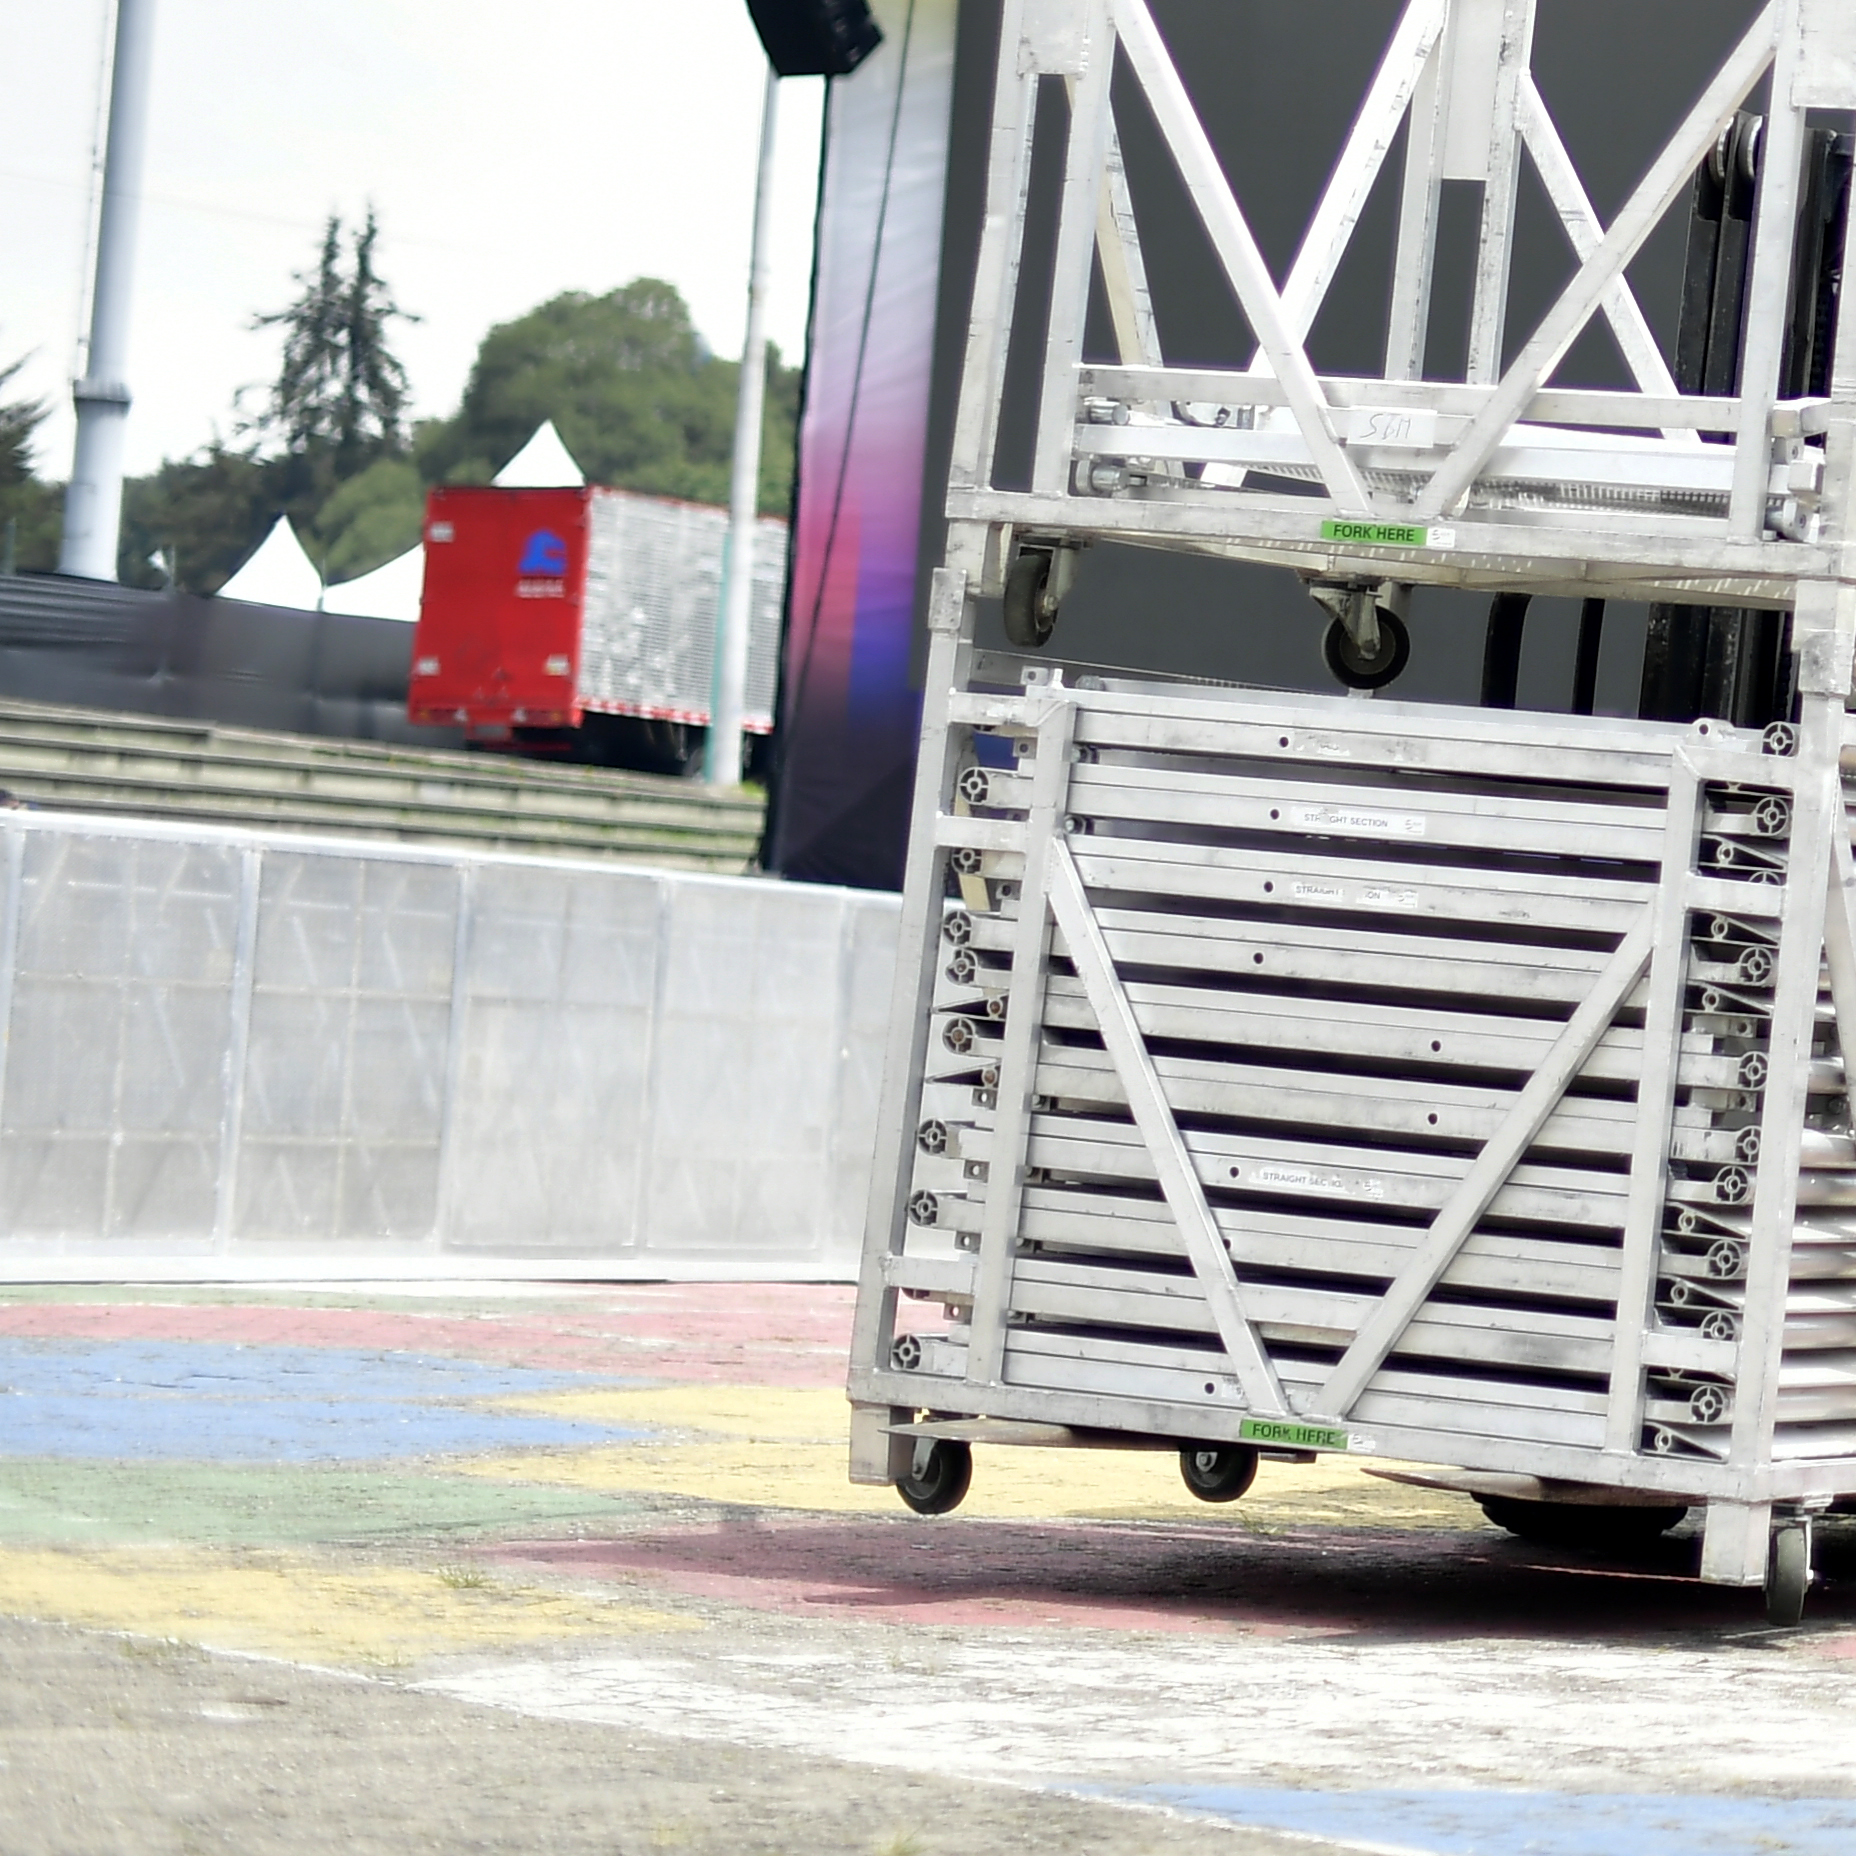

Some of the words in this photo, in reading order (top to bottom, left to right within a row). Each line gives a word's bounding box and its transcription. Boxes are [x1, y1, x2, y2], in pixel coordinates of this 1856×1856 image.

[1333, 524, 1372, 539] FORK
[1376, 527, 1415, 542] HERE
[1350, 818, 1388, 828] SECTION
[1263, 1171, 1306, 1184] STRAIGHT
[1252, 1423, 1291, 1441] FORK
[1296, 1428, 1336, 1445] HERE
